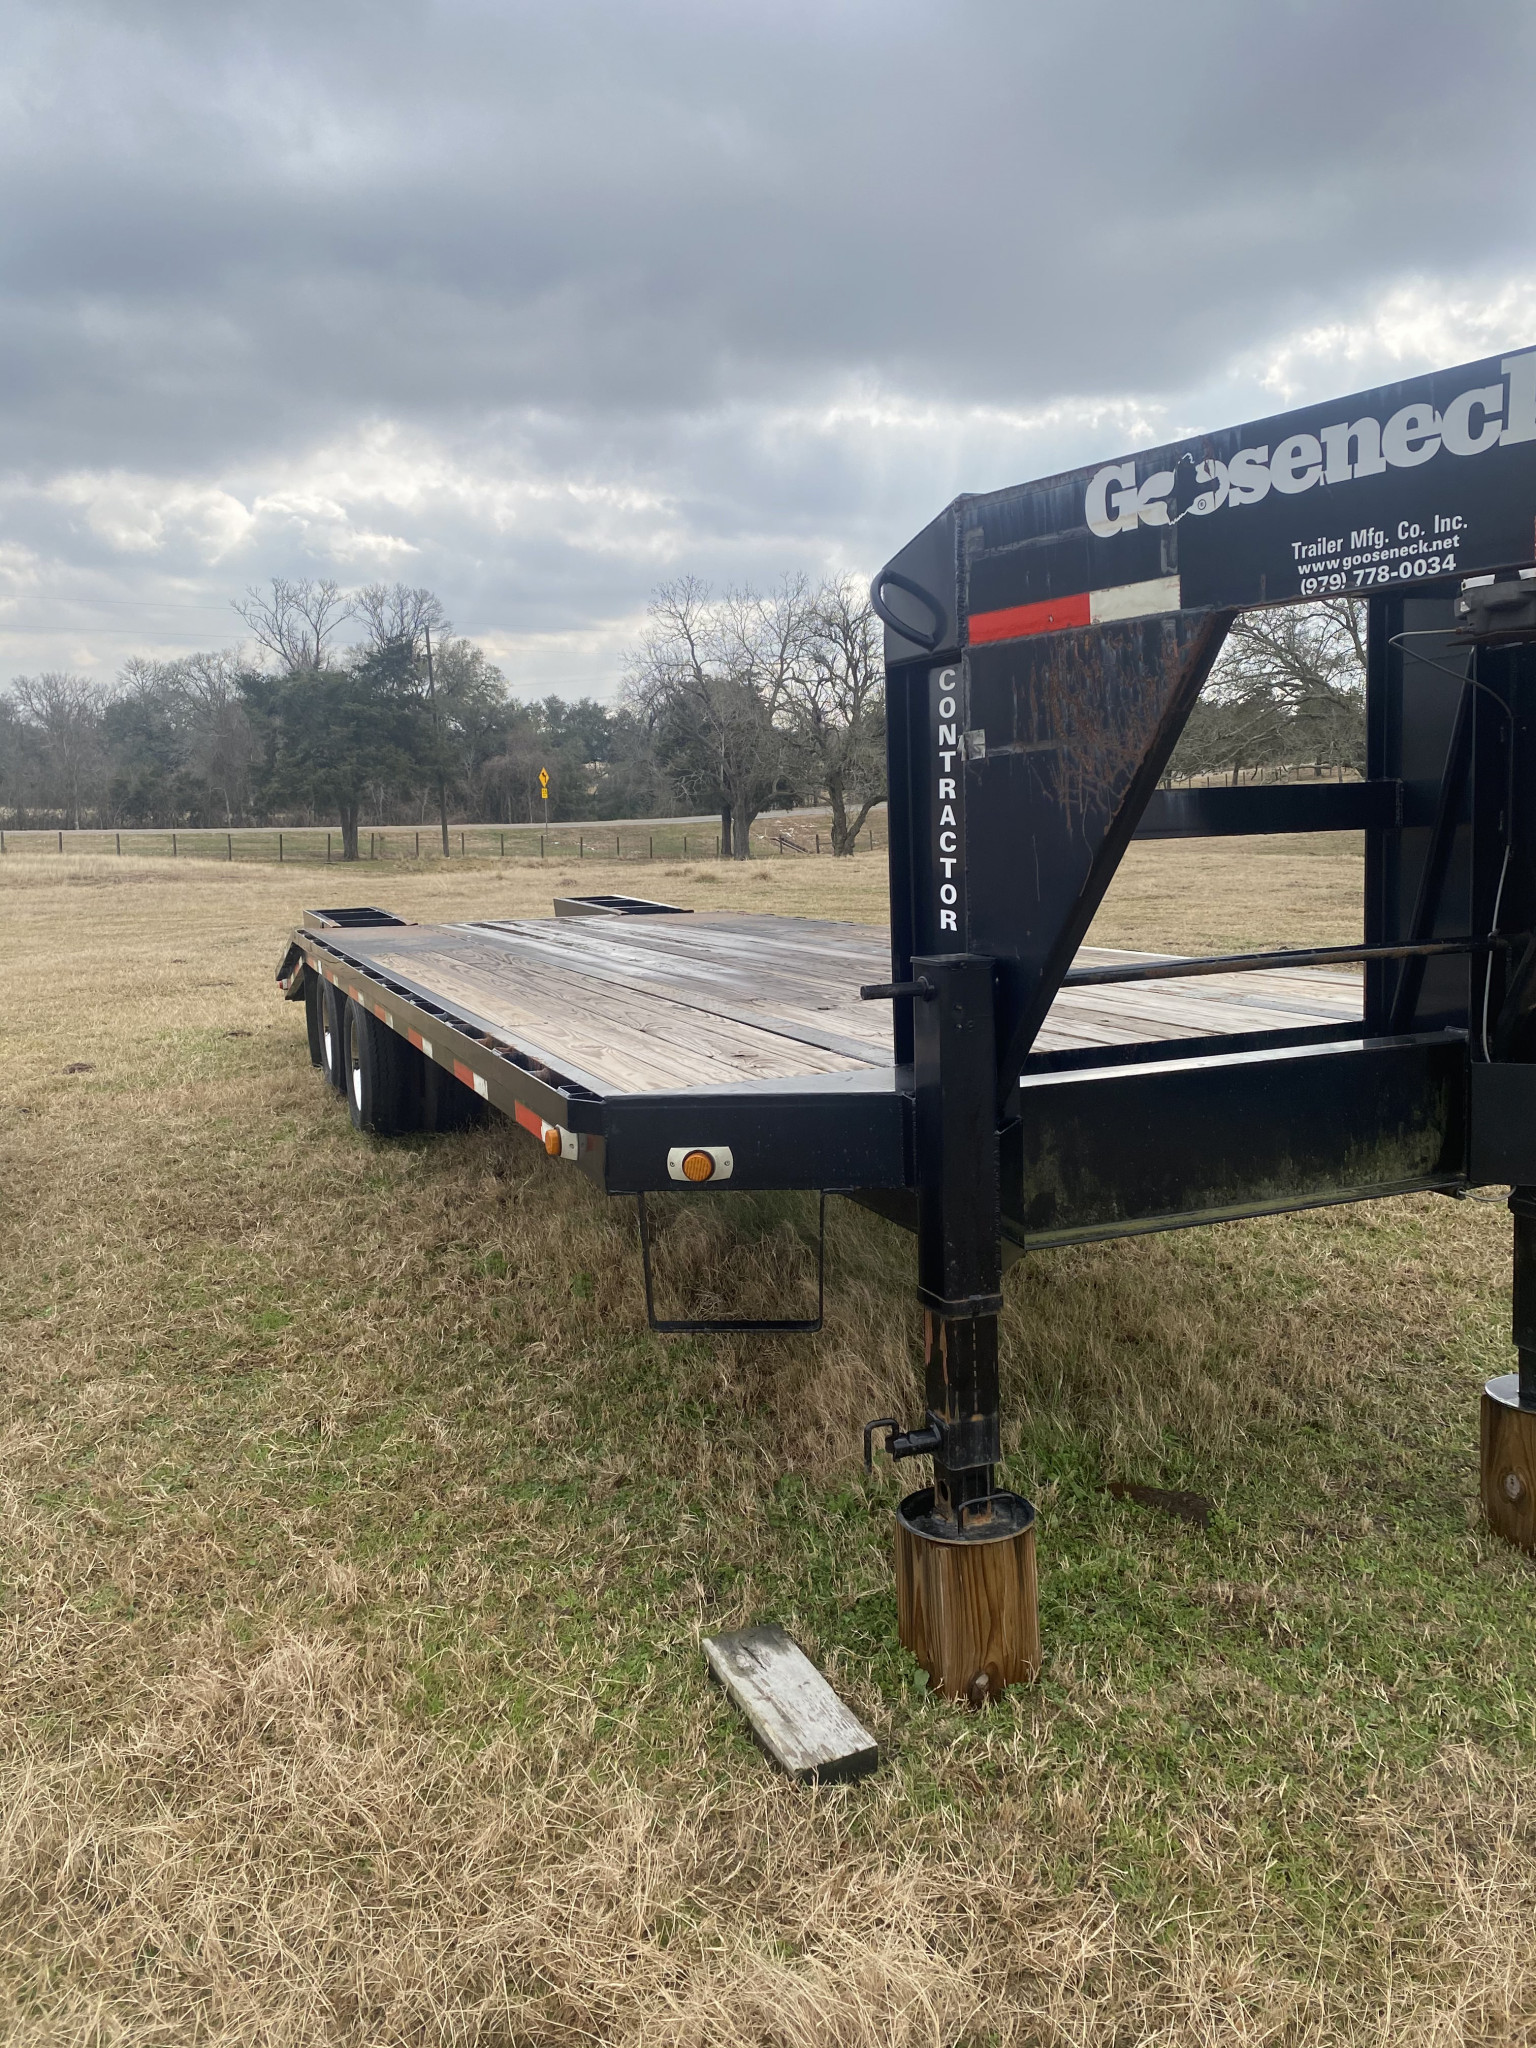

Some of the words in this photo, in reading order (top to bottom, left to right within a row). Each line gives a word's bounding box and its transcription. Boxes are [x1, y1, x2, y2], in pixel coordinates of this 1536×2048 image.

[1291, 536, 1343, 560] Trailer
[1350, 527, 1389, 549] Mfg.
[1397, 520, 1426, 540] Co.
[1434, 514, 1468, 534] Inc.
[1300, 572, 1347, 596] (979)
[1352, 553, 1457, 587] 778-0034
[938, 669, 957, 932] CONTRACTOR
